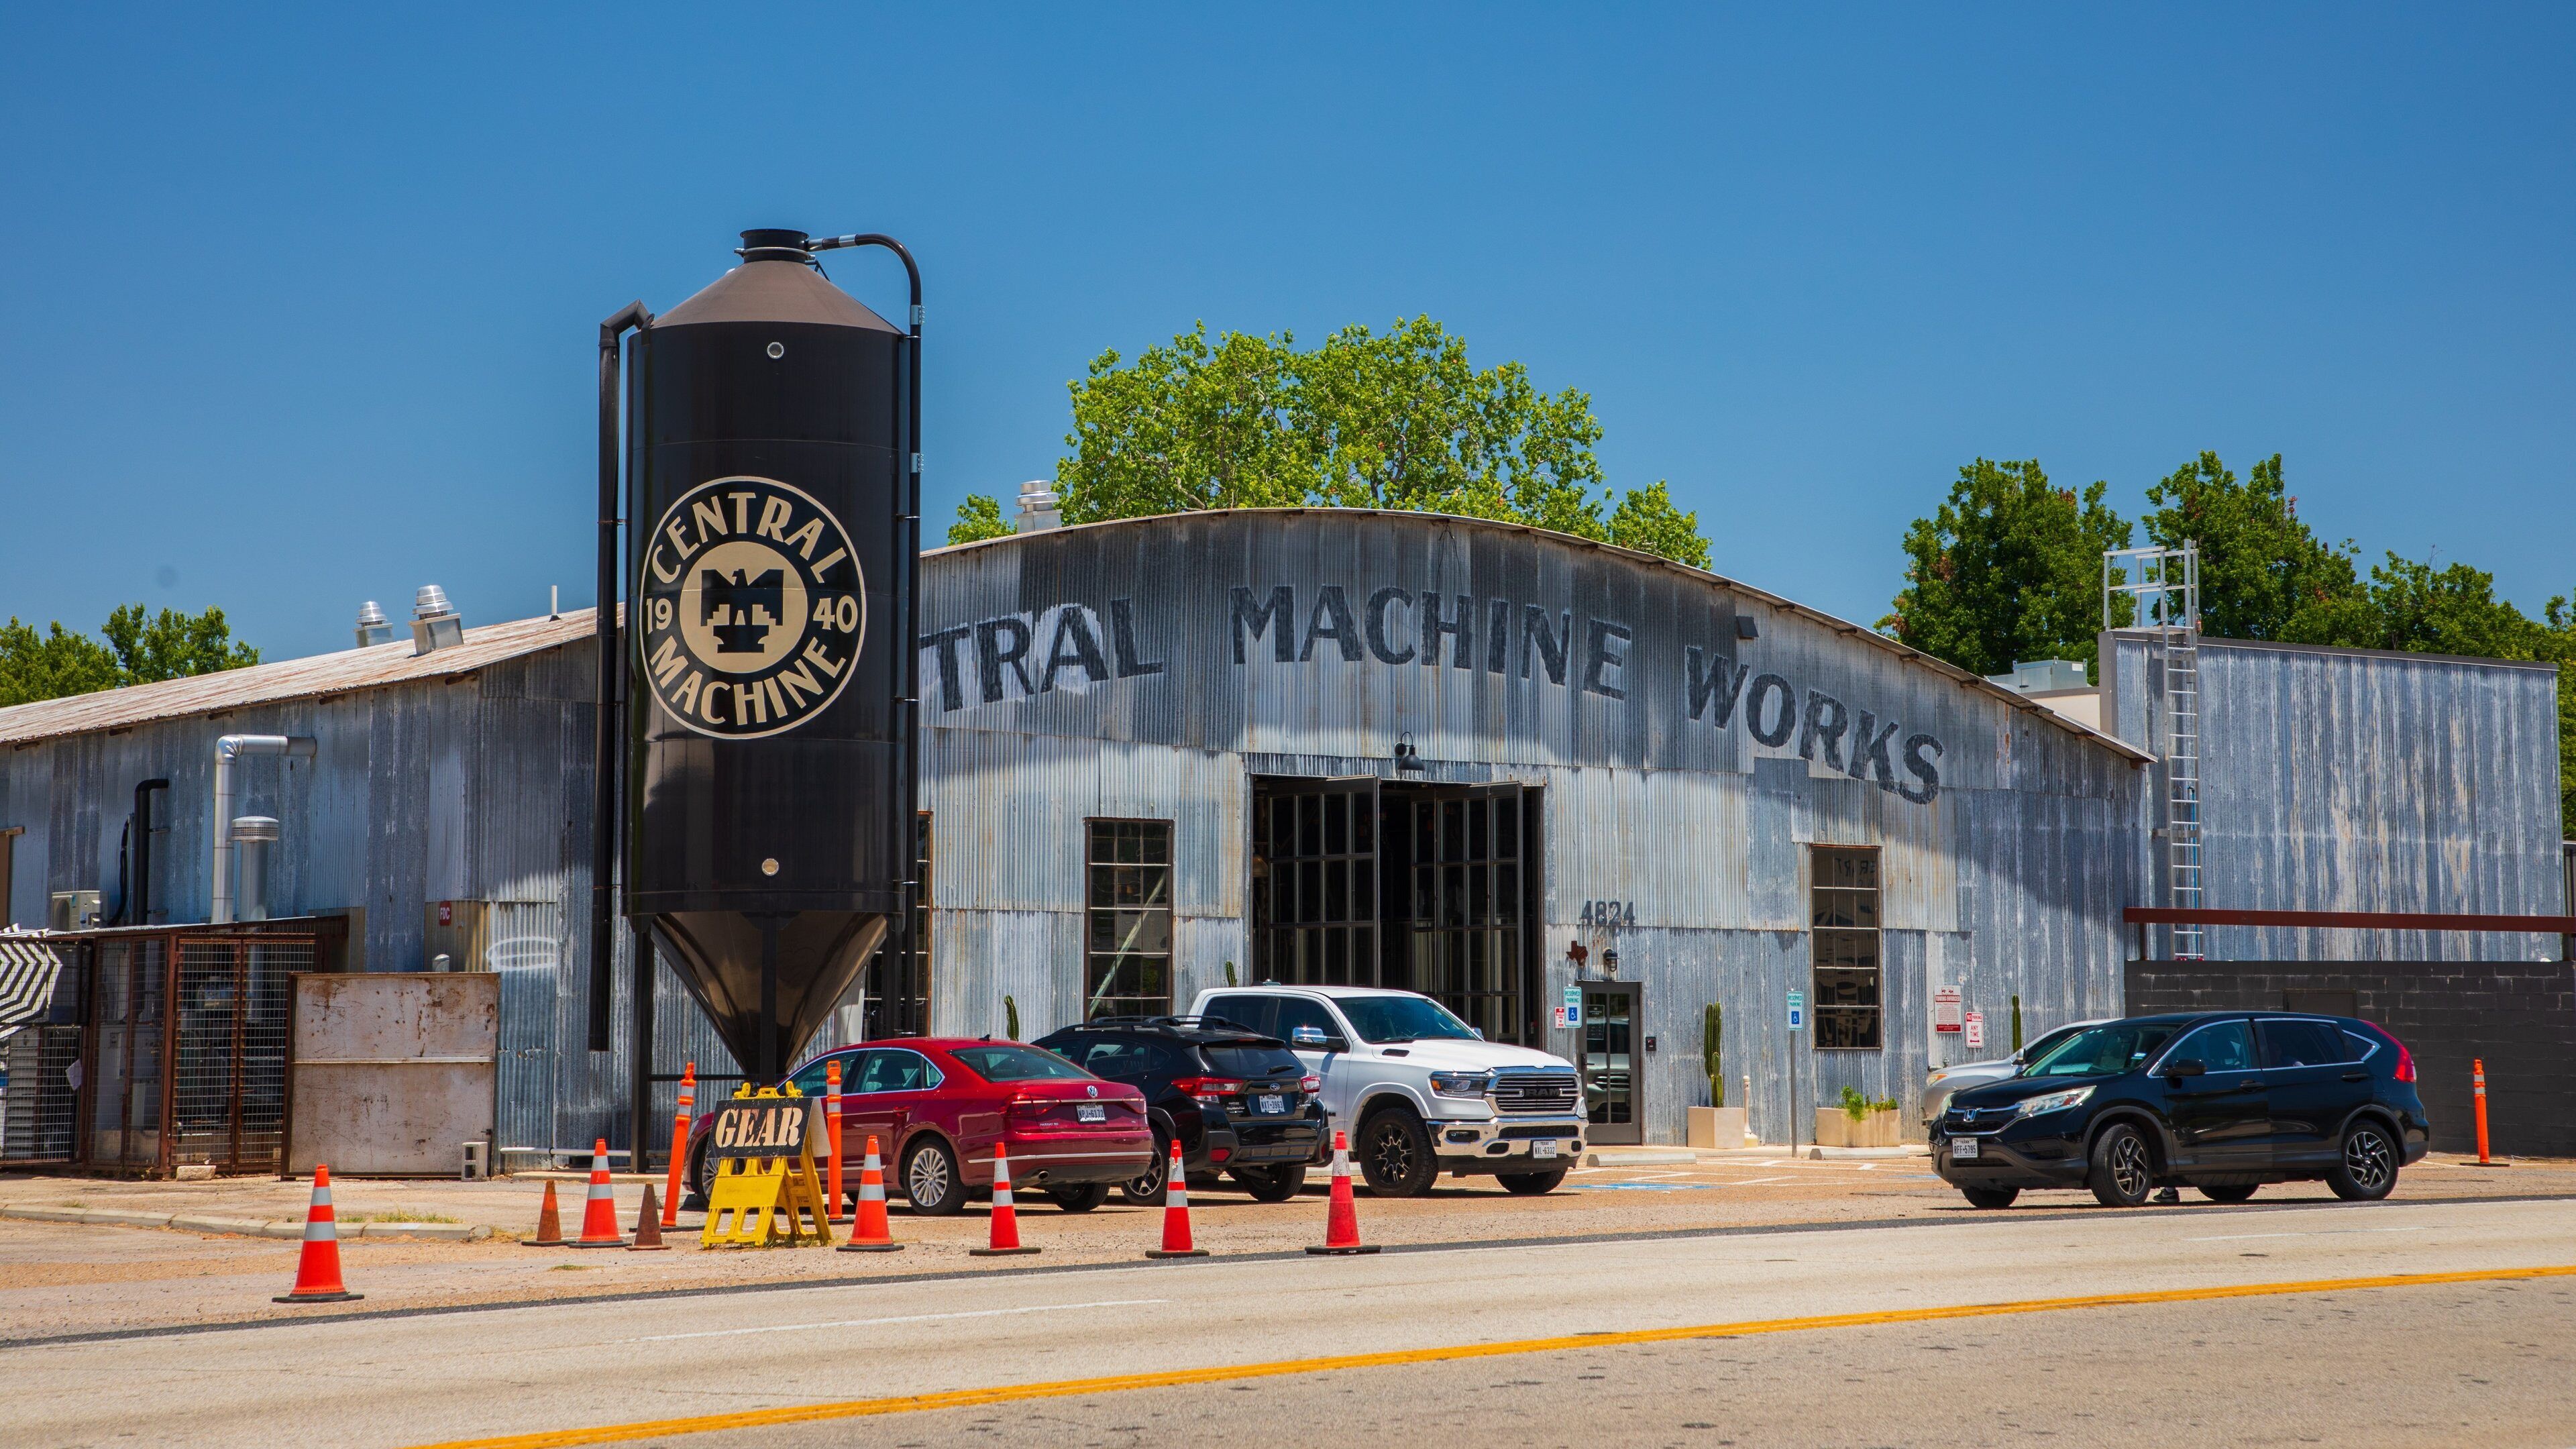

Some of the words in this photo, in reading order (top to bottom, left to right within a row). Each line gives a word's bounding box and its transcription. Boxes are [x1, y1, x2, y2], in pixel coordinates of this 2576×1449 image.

[652, 492, 847, 584] CENTRAL
[646, 598, 673, 635] 19
[813, 595, 858, 633] 40
[650, 637, 846, 726] MACHINE
[1230, 585, 1631, 700] MACHINE
[1686, 645, 1945, 805] WORKS
[439, 907, 450, 920] FDC
[1579, 900, 1635, 927] 4824
[1525, 1088, 1559, 1097] RAM
[715, 1107, 803, 1148] GEAR
